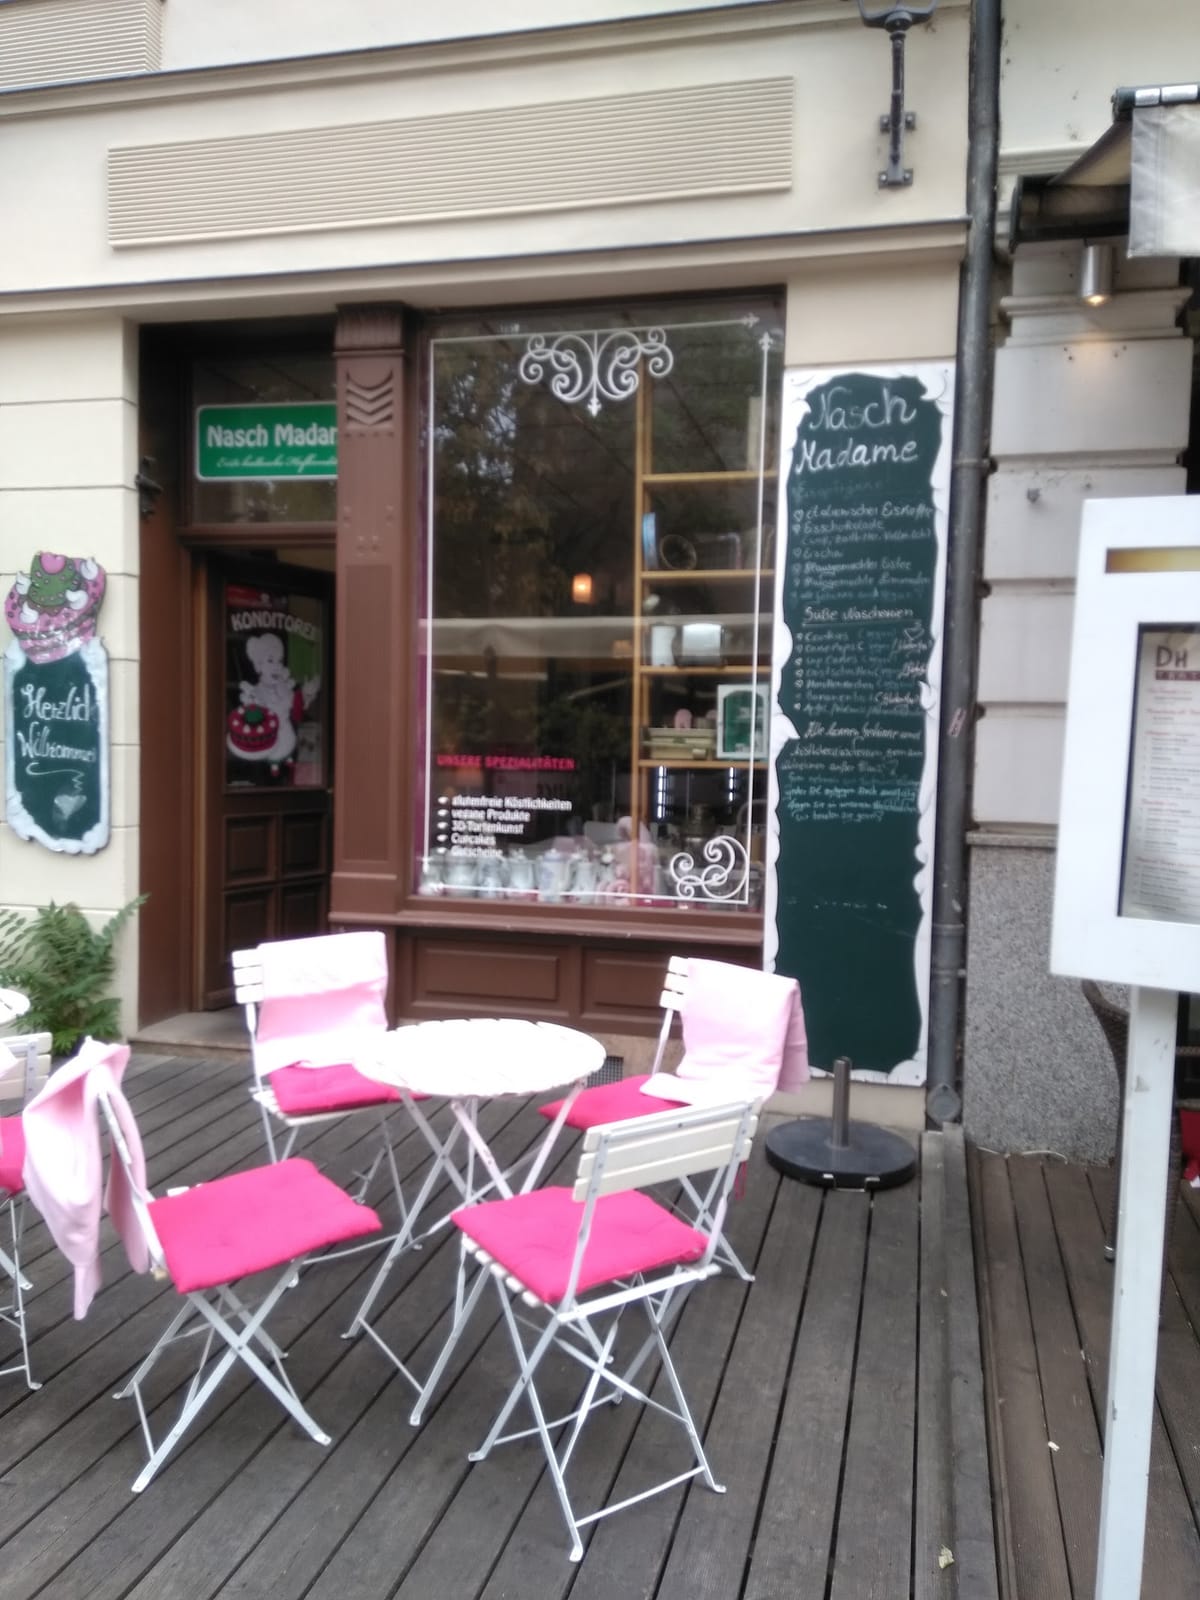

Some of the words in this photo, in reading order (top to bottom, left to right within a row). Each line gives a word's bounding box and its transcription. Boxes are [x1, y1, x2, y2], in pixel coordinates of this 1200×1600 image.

[809, 386, 916, 430] Nasch
[207, 424, 268, 447] Nasch
[795, 438, 918, 475] Madame
